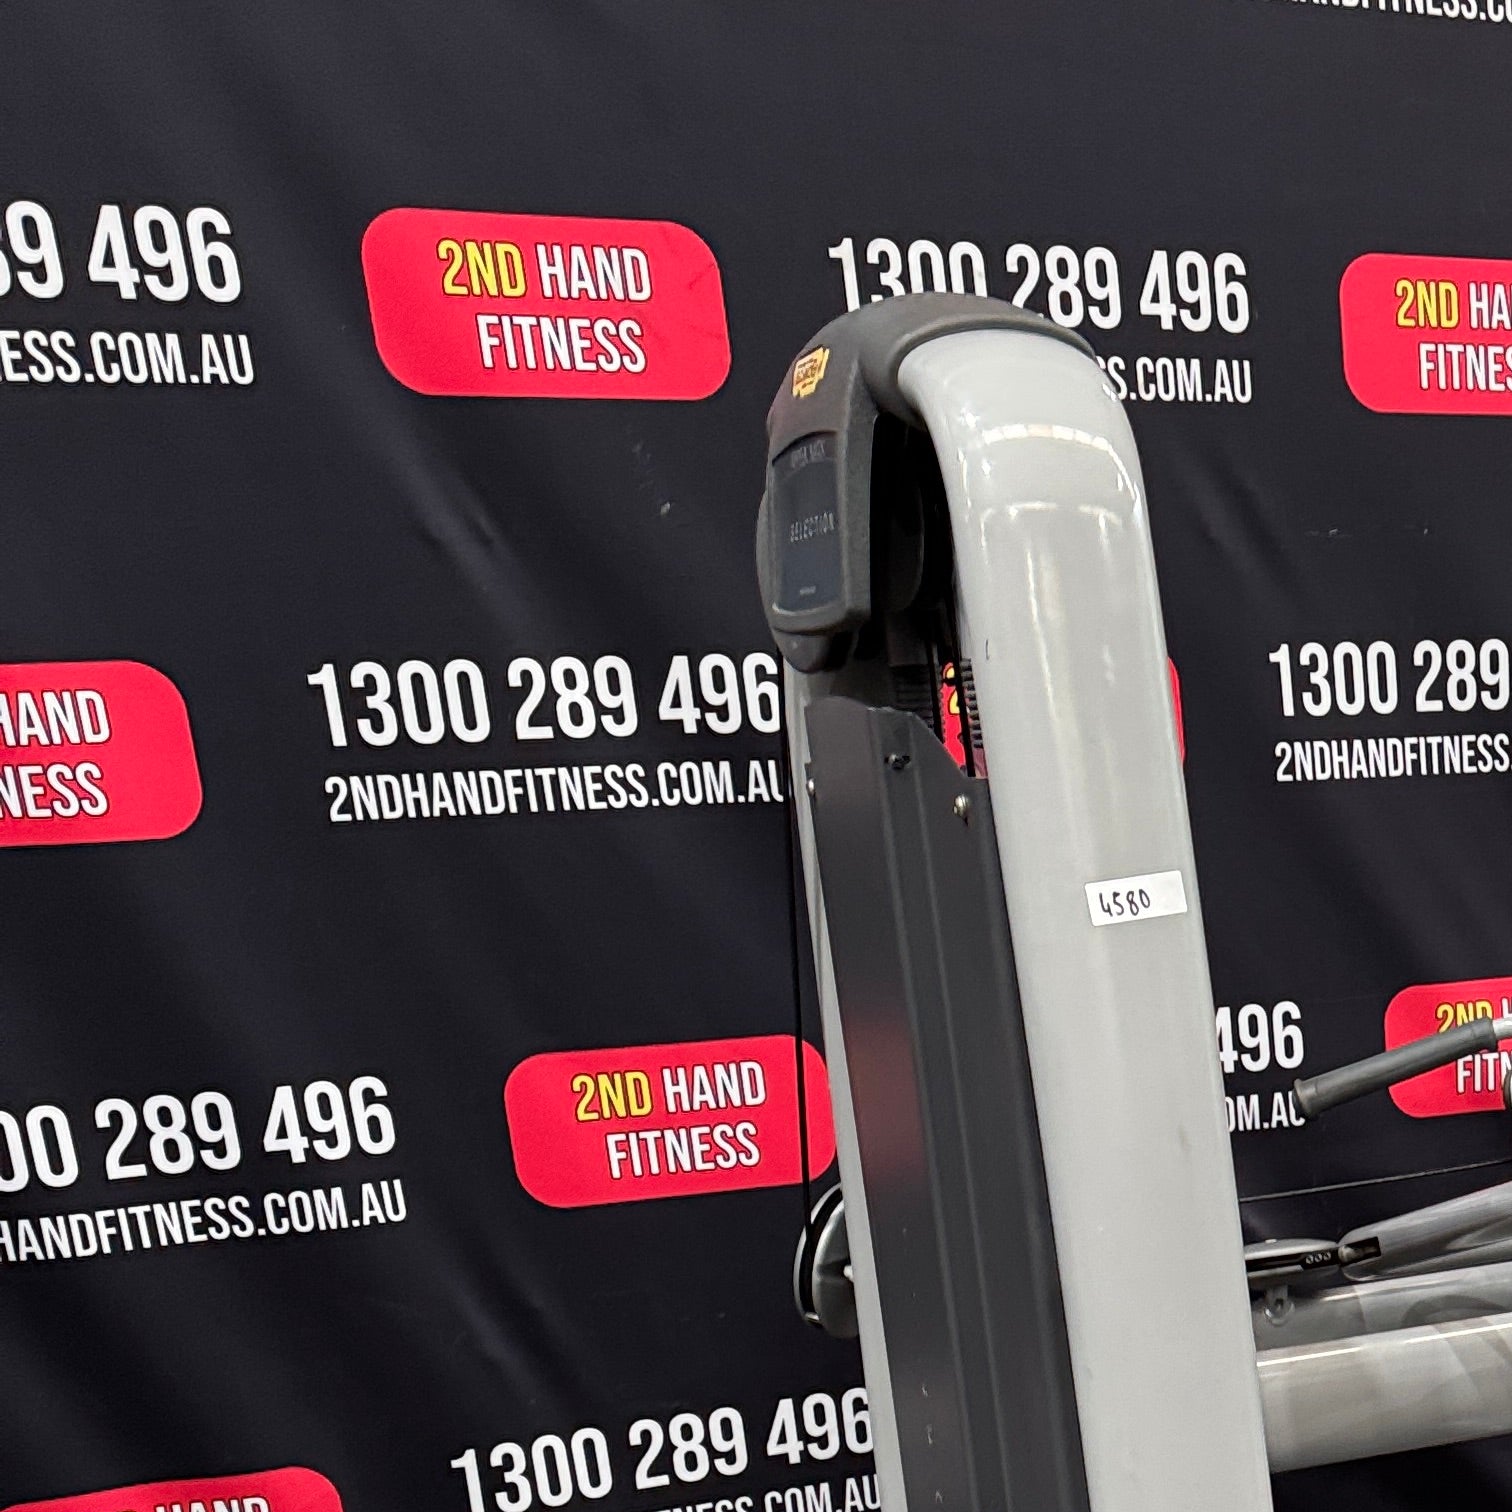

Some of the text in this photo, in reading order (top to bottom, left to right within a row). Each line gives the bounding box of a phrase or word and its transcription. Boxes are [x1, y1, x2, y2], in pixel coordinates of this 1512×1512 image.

[87, 204, 241, 303] 496
[437, 239, 651, 301] 2ND HAND
[1005, 243, 1122, 330] 289
[1139, 249, 1250, 334] 496
[1395, 279, 1459, 328] 2ND
[476, 314, 646, 373] FITNESS
[306, 652, 781, 747] 1300 289 496
[1268, 640, 1398, 717] 1300
[1413, 638, 1510, 713] 289
[1098, 888, 1151, 917] 4580
[572, 1061, 766, 1121] 2ND HAND
[94, 1091, 241, 1181] 289
[263, 1075, 396, 1164] 496
[606, 1121, 760, 1179] FITNESS
[628, 1406, 748, 1490] 289
[766, 1383, 876, 1465] 496
